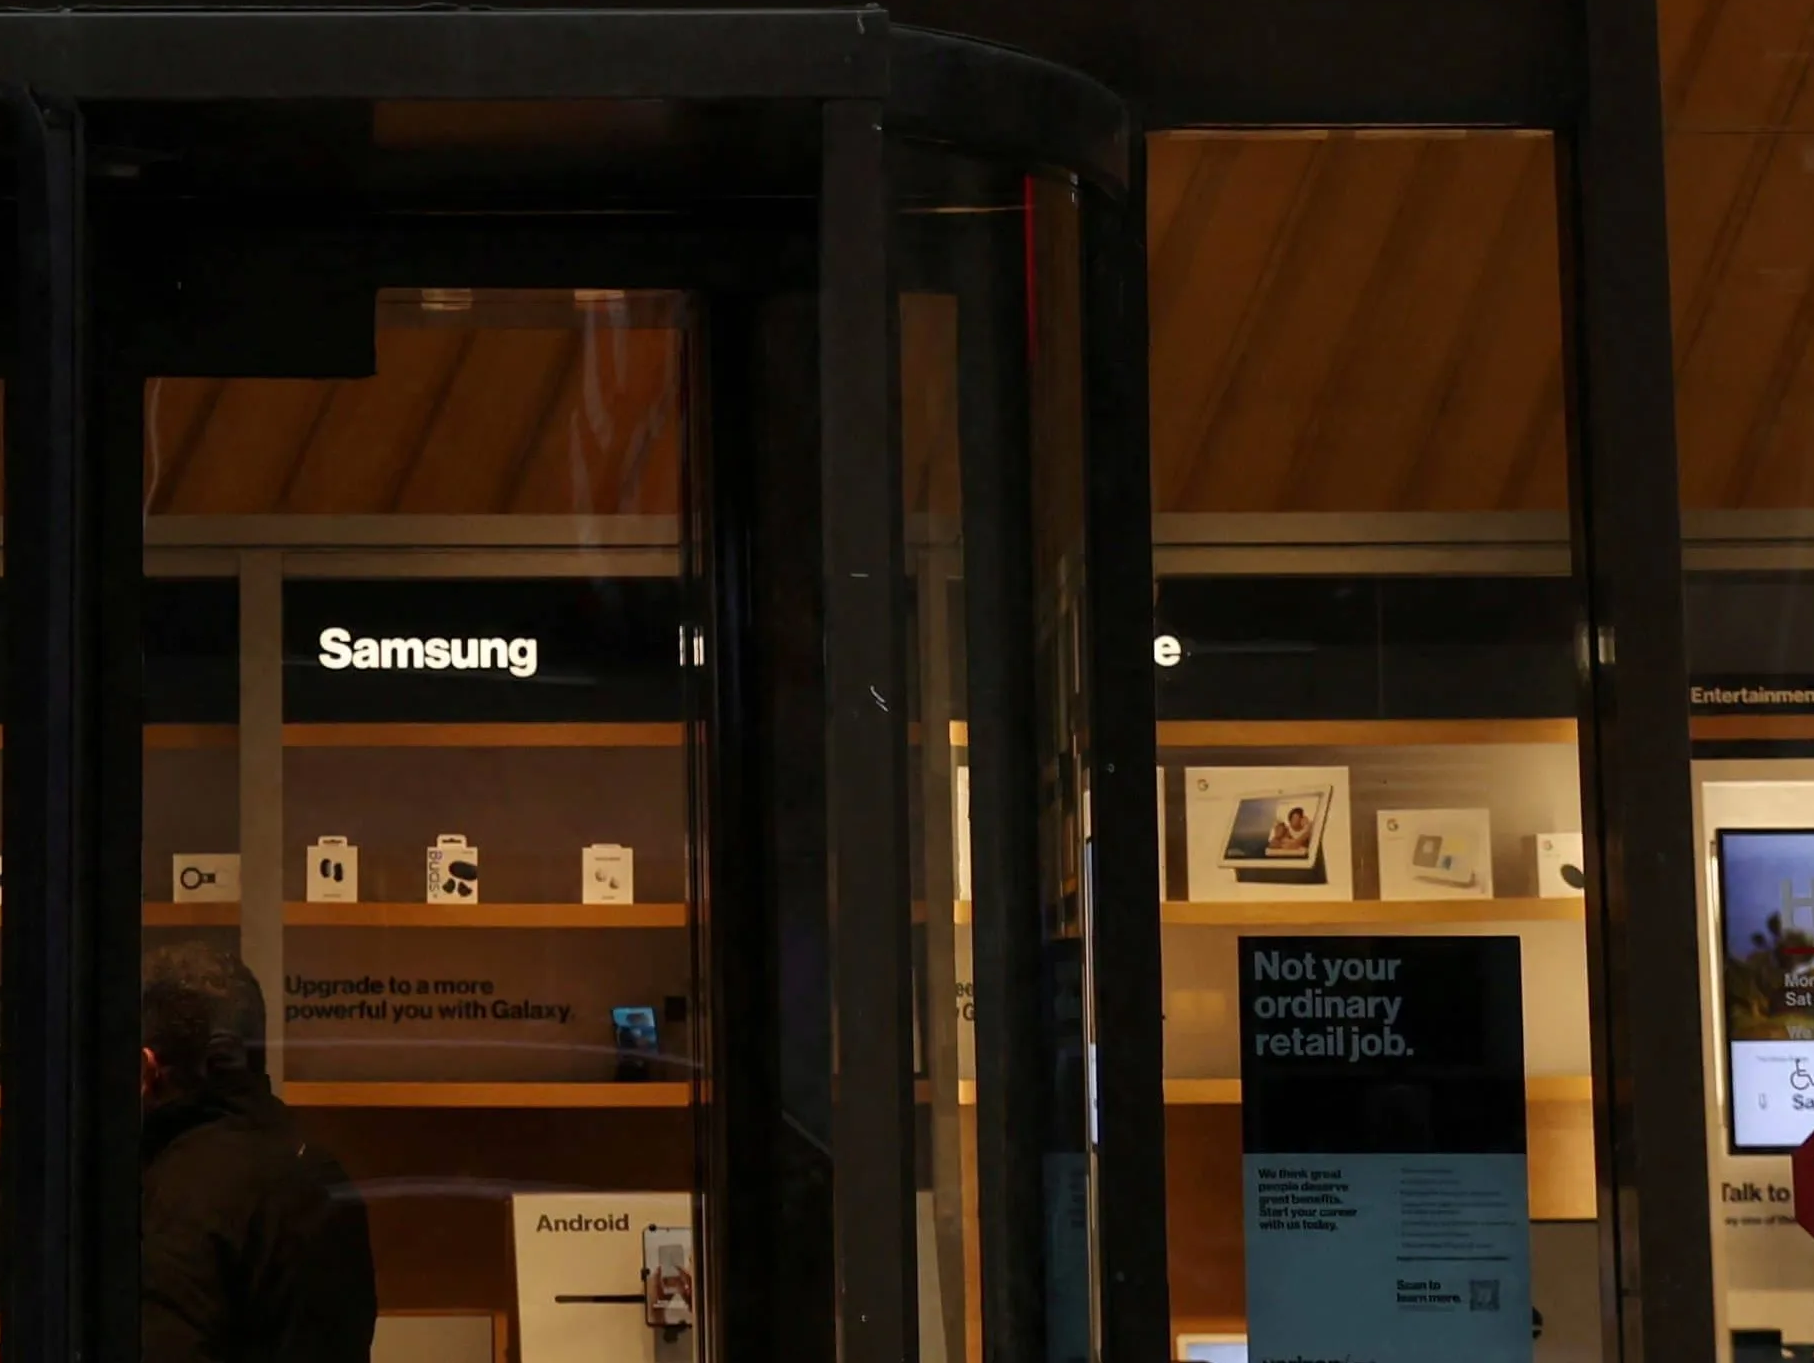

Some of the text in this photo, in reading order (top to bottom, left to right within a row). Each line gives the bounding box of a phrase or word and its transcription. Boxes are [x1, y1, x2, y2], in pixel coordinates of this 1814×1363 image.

[318, 626, 538, 677] Samsung
[1253, 951, 1401, 991] Not your
[285, 976, 494, 997] Upgrade to a more
[1254, 988, 1401, 1026] ordinary
[1784, 992, 1813, 1007] Sat
[284, 1000, 387, 1023] powerful
[391, 1005, 434, 1023] you
[438, 1000, 487, 1019] with
[1254, 1027, 1415, 1064] retail job.
[1767, 1183, 1791, 1203] to
[536, 1213, 630, 1233] Android
[1397, 1279, 1441, 1291] Scan to
[1397, 1292, 1427, 1303] learn
